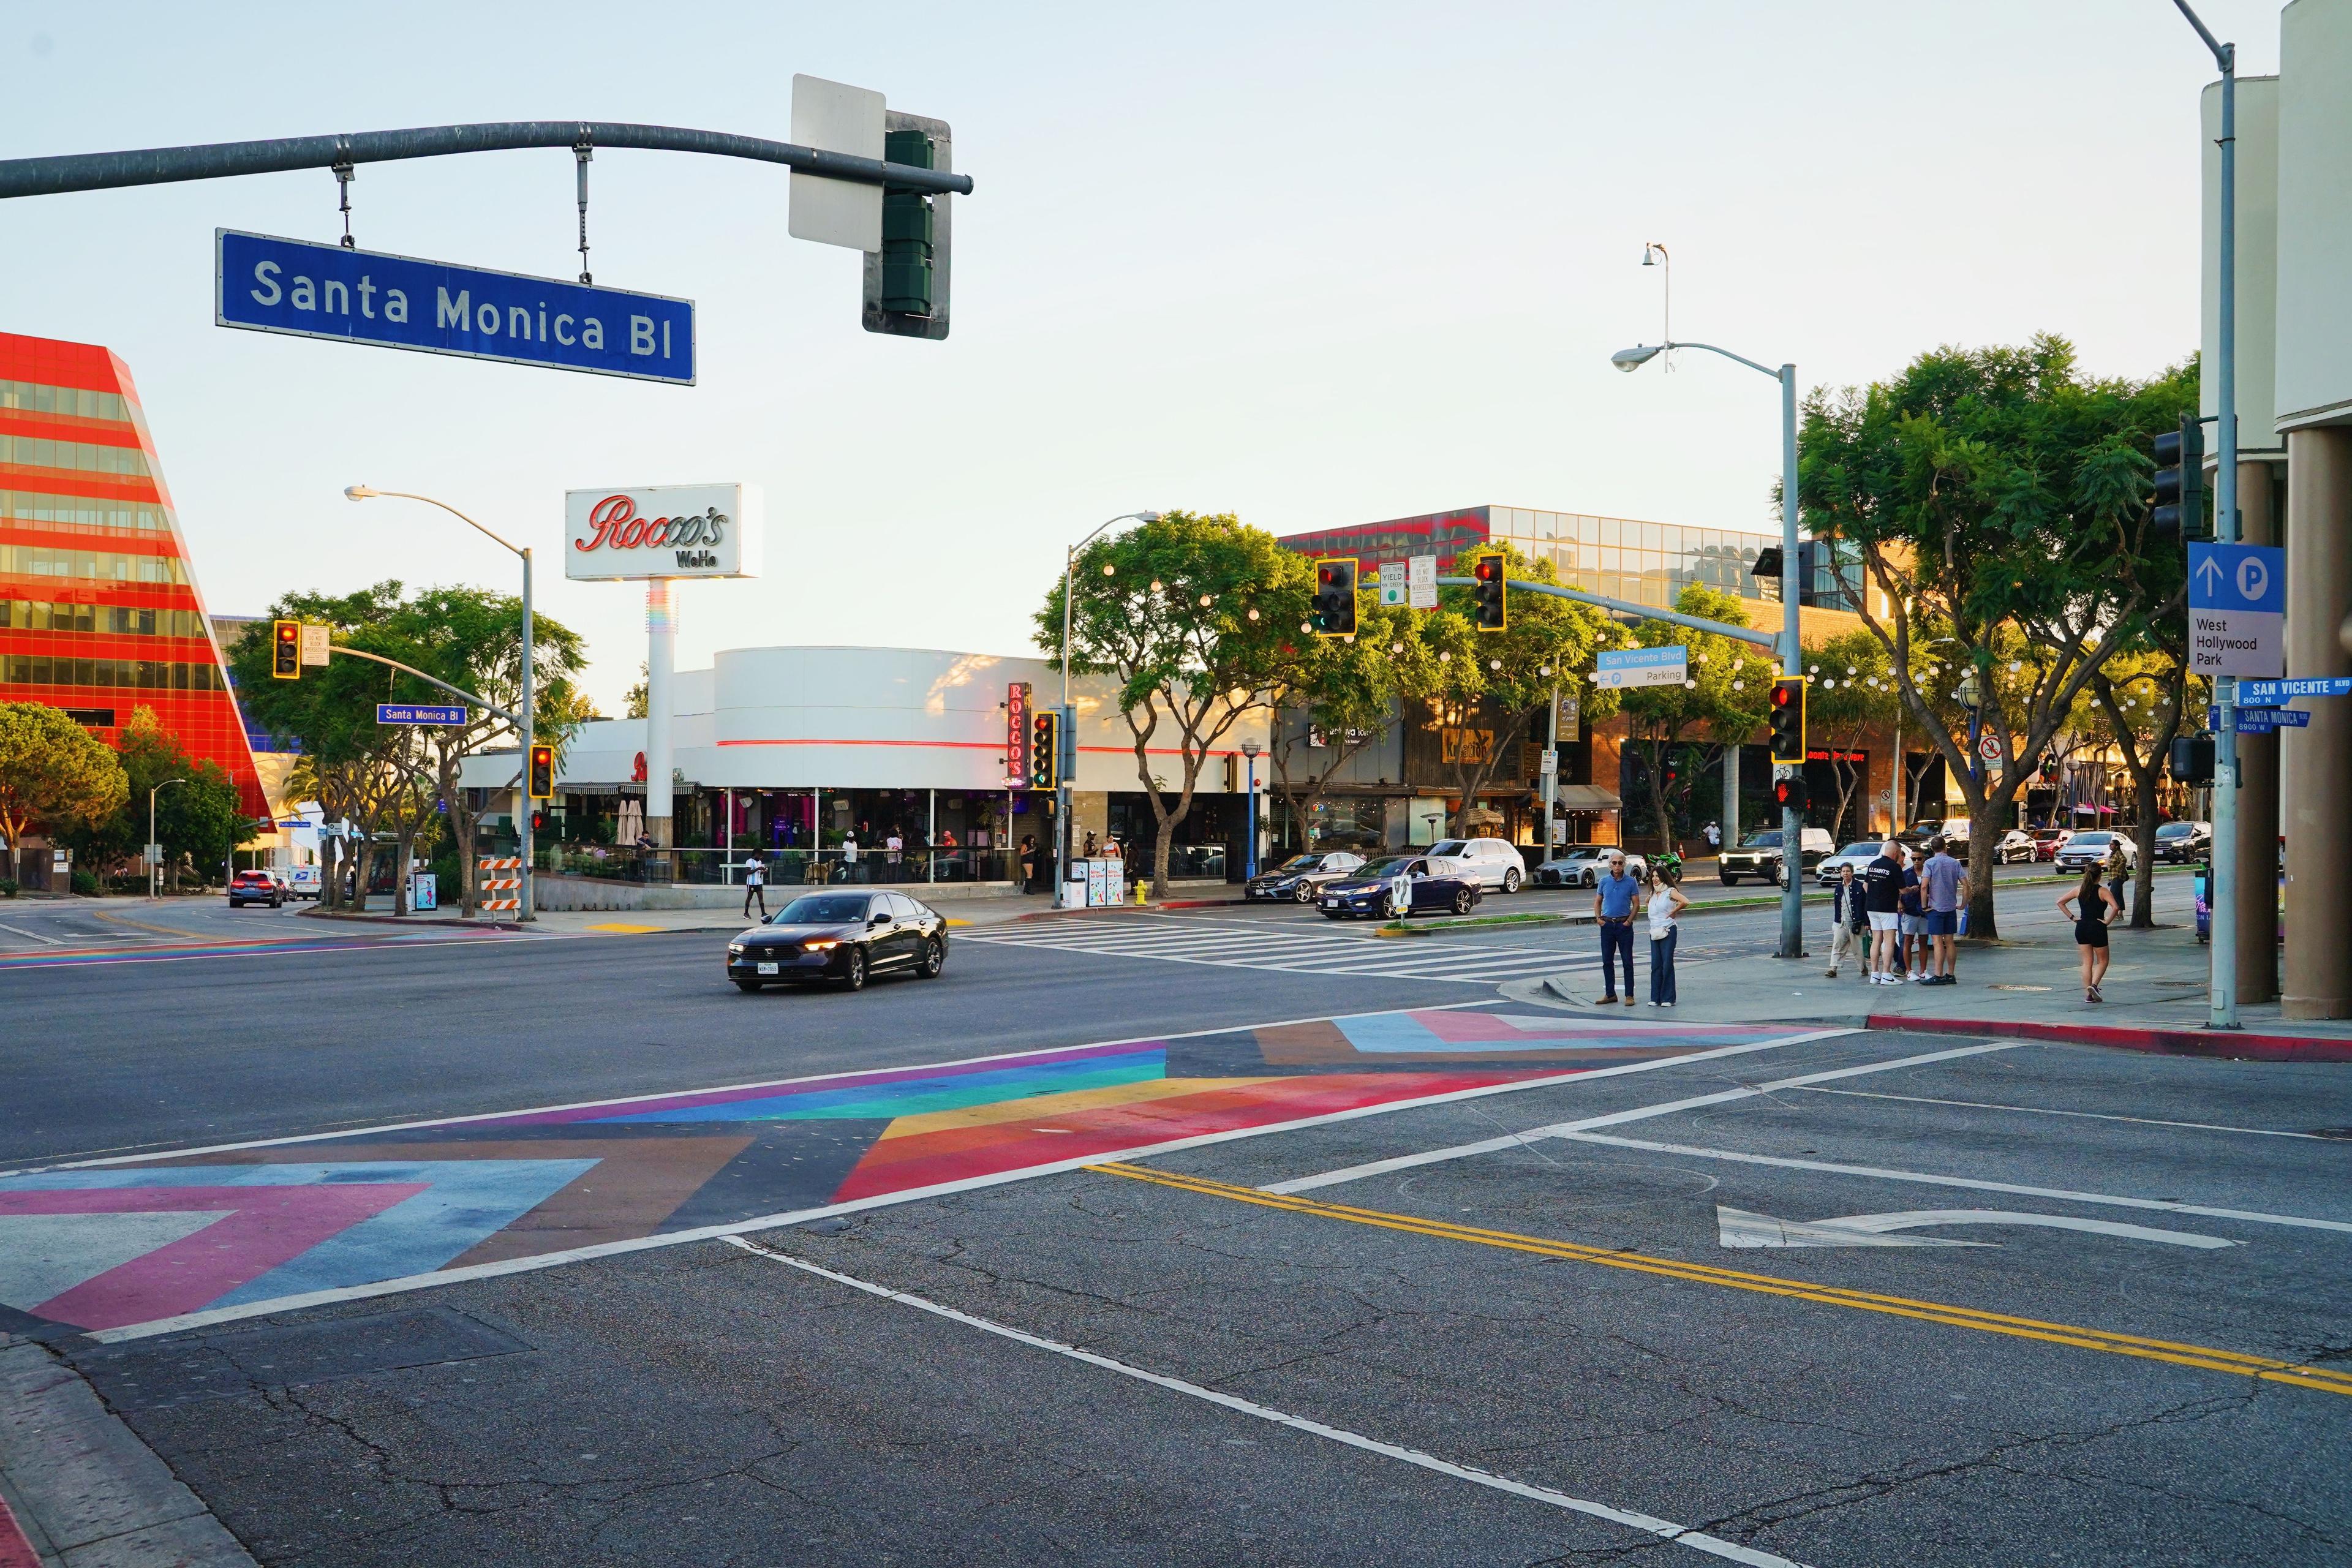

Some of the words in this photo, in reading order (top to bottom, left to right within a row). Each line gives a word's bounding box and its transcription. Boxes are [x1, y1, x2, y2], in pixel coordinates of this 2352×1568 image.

[250, 260, 409, 323] Santa
[437, 285, 605, 350] Monica
[630, 315, 671, 360] Bl
[575, 494, 729, 552] Rocco's
[676, 550, 718, 568] WeHo
[2196, 618, 2227, 631] West
[2196, 635, 2257, 650] Hollywood
[1606, 656, 1622, 665] San
[1624, 654, 1659, 663] Vicente
[1661, 650, 1681, 661] Blvd
[2197, 653, 2222, 666] Park
[1647, 671, 1681, 680] Parking
[2253, 683, 2275, 696] SAN
[2282, 680, 2329, 695] VICENTE
[386, 709, 412, 719] Santa
[416, 710, 446, 720] Monica
[450, 710, 458, 720] Bl
[2244, 710, 2269, 723] SANTA
[2271, 712, 2297, 724] MONICA
[1447, 735, 1487, 758] kation
[1807, 751, 1829, 760] oontz
